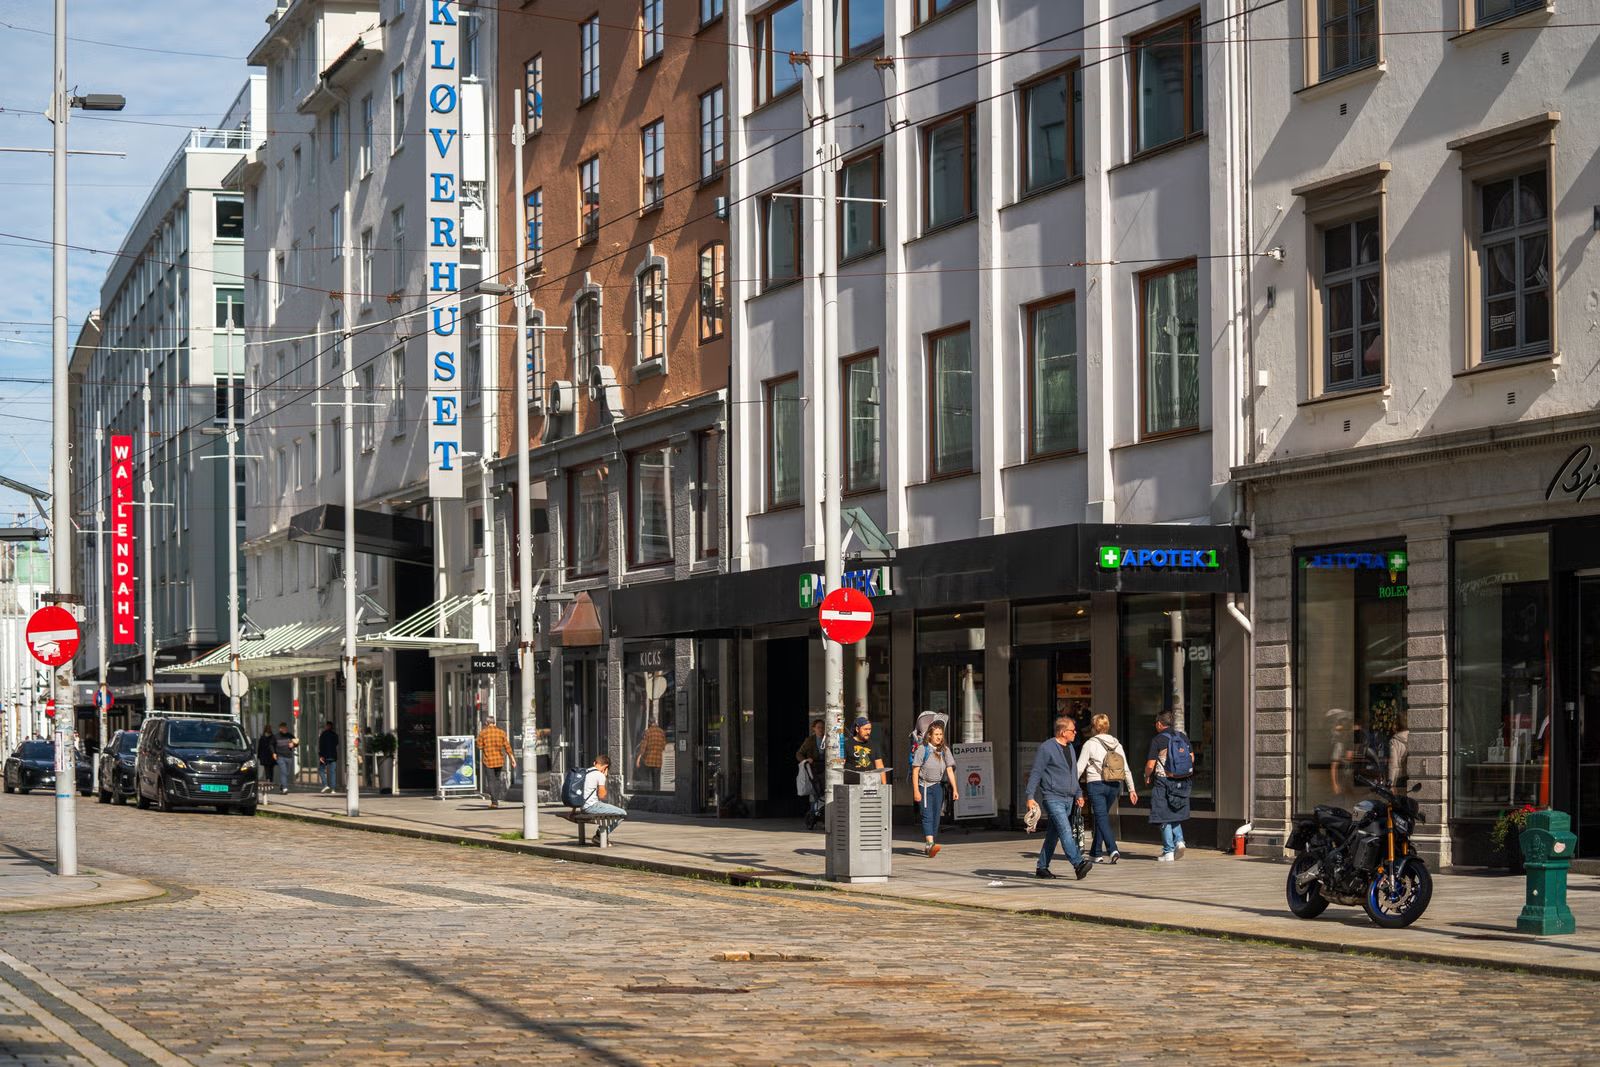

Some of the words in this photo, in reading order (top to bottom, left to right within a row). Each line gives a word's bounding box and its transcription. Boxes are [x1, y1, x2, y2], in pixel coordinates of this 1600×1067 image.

[429, 0, 459, 471] KLØVERHUSET
[114, 446, 129, 634] WALLENDAHL
[640, 651, 661, 666] KICKS
[961, 746, 987, 754] APOTEK
